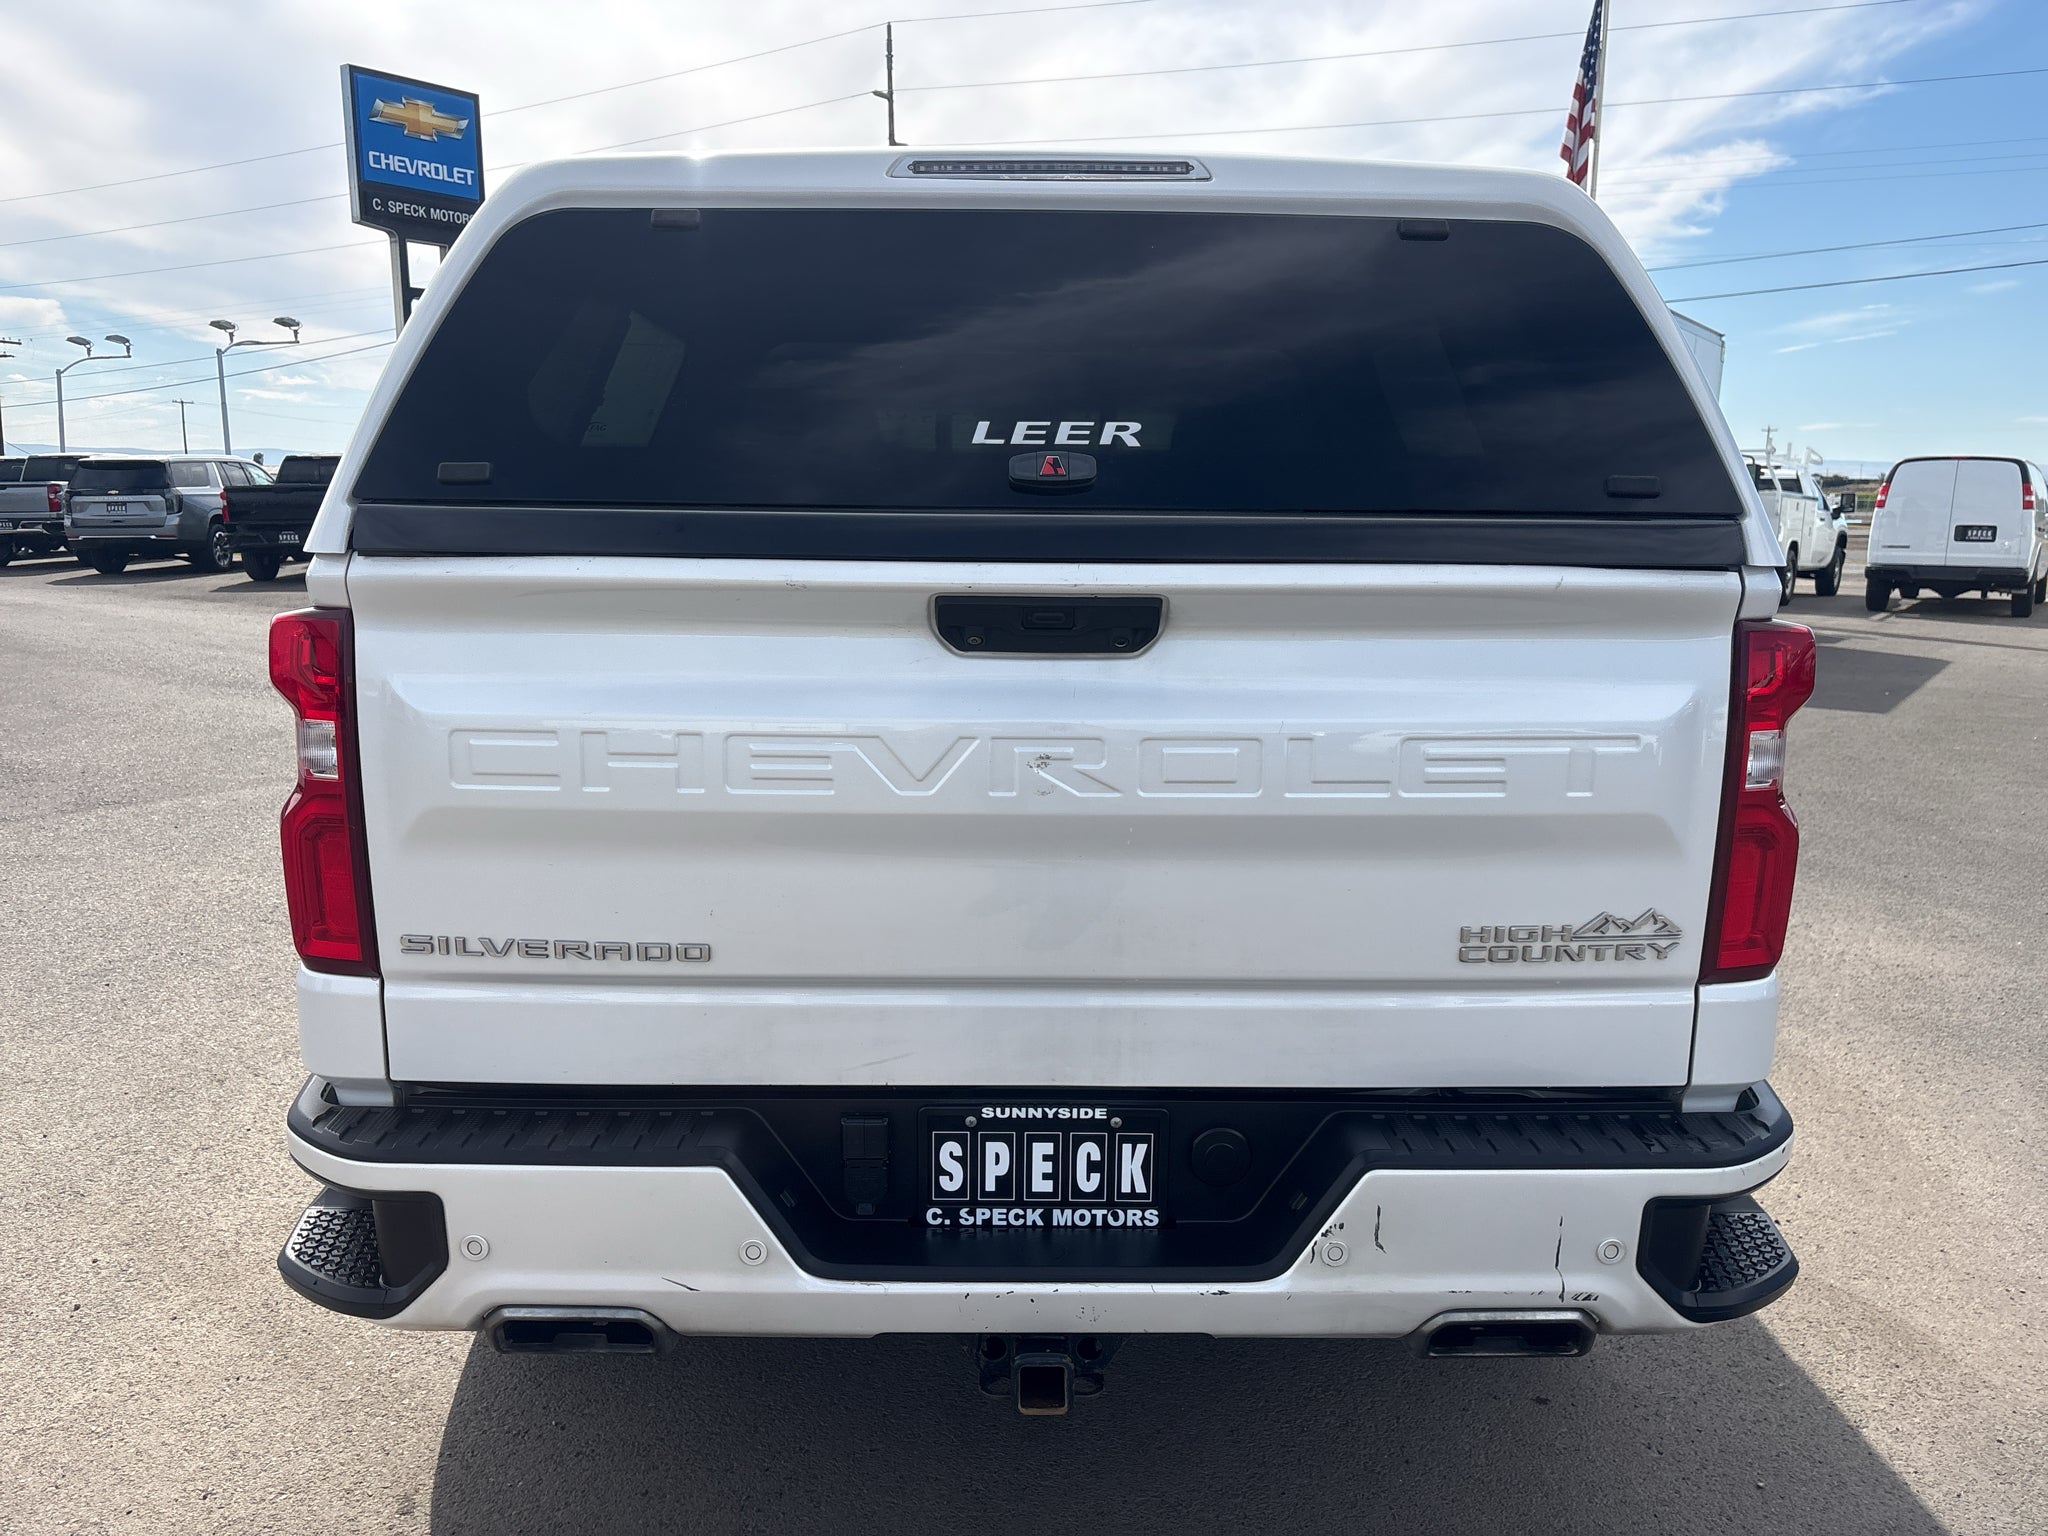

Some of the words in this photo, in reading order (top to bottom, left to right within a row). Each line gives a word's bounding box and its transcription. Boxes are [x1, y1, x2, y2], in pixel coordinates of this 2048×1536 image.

[368, 150, 475, 186] CHEVROLET
[372, 197, 385, 211] C.
[387, 200, 427, 219] SPECK
[971, 420, 1142, 447] LEER
[1967, 529, 1992, 537] SPECK
[448, 728, 1641, 799] CHEVROLET
[1459, 924, 1574, 944] HIGH
[400, 933, 711, 963] SILVERADO
[1458, 942, 1681, 964] COUNTRY
[980, 1107, 1108, 1119] SUNNYSIDE
[938, 1140, 1149, 1194] SPECK
[925, 1207, 951, 1226] C.
[958, 1207, 1045, 1226] SPECK
[1051, 1208, 1160, 1227] MOTORS
